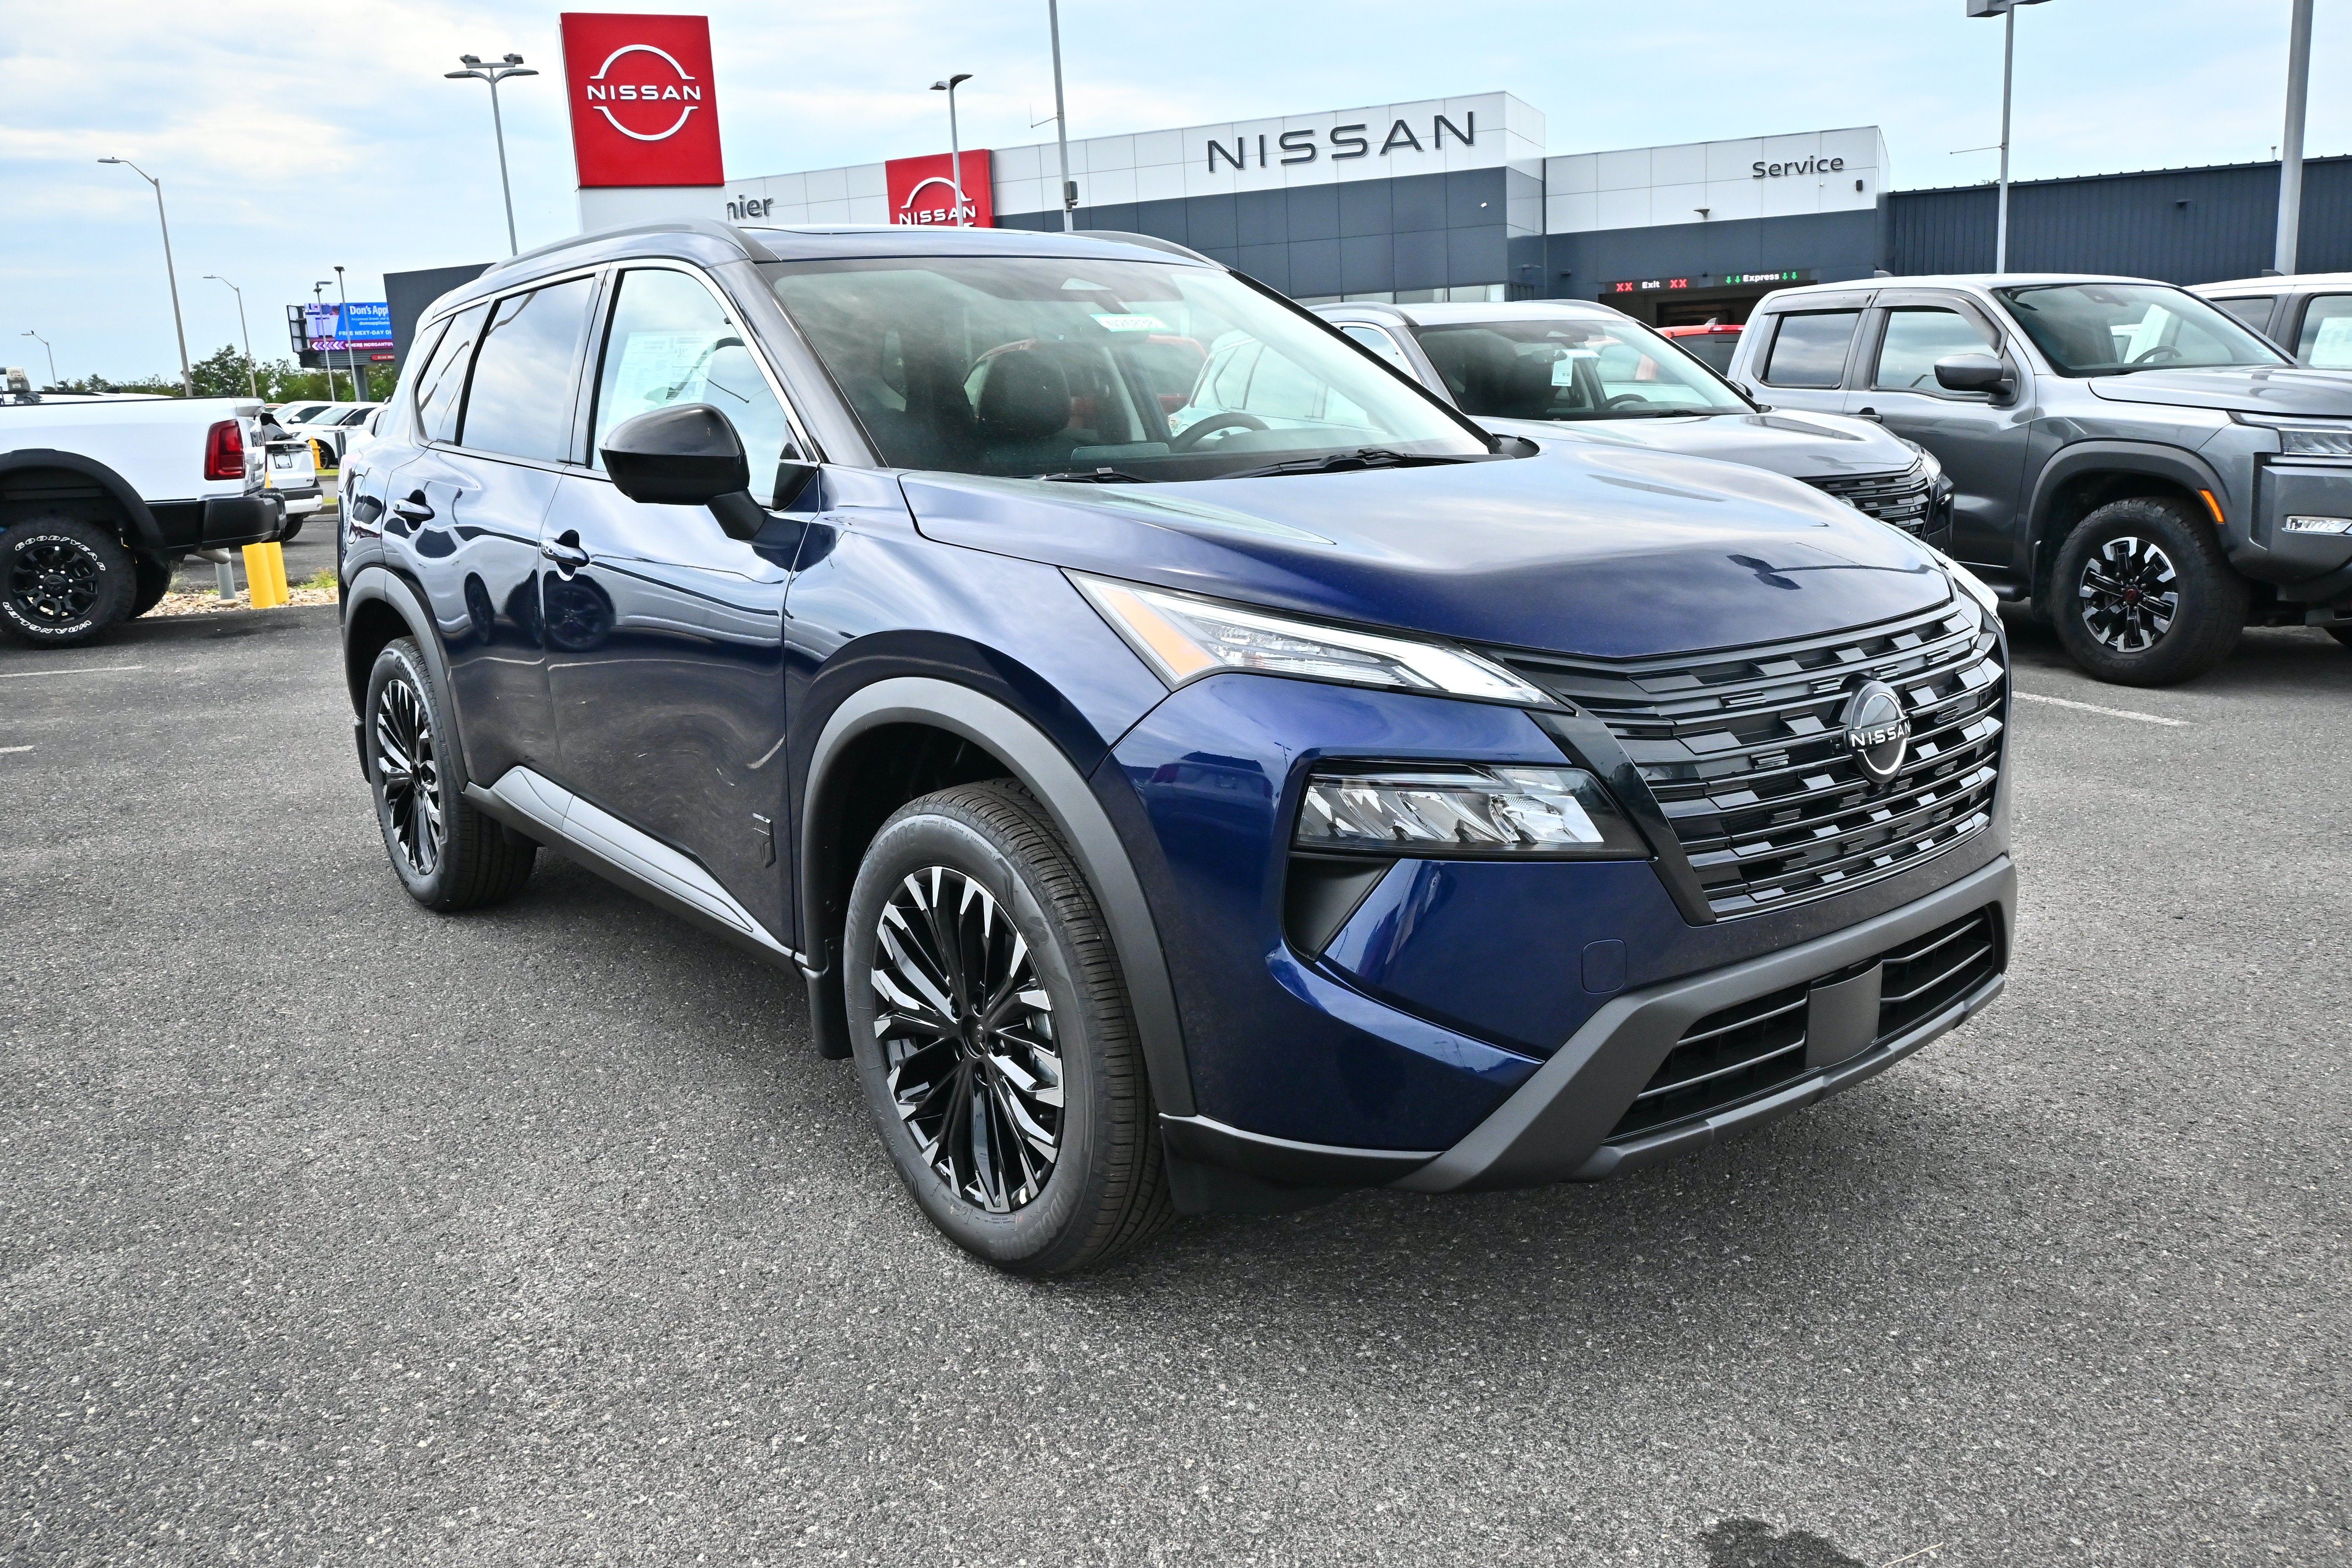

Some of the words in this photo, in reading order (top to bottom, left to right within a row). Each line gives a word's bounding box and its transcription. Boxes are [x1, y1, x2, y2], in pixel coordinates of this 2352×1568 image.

[587, 85, 701, 100] NISSAN
[1207, 111, 1475, 173] NISSAN
[1752, 155, 1844, 178] Service
[898, 205, 976, 225] NISSAN
[1642, 280, 1661, 289] Exit
[1743, 273, 1780, 282] Express
[349, 305, 372, 315] Don's
[15, 535, 106, 571] GOODYEAR
[3, 602, 92, 634] WRANGLER
[395, 656, 435, 742] BRIDGESTONE
[1851, 720, 1911, 747] NISSAN
